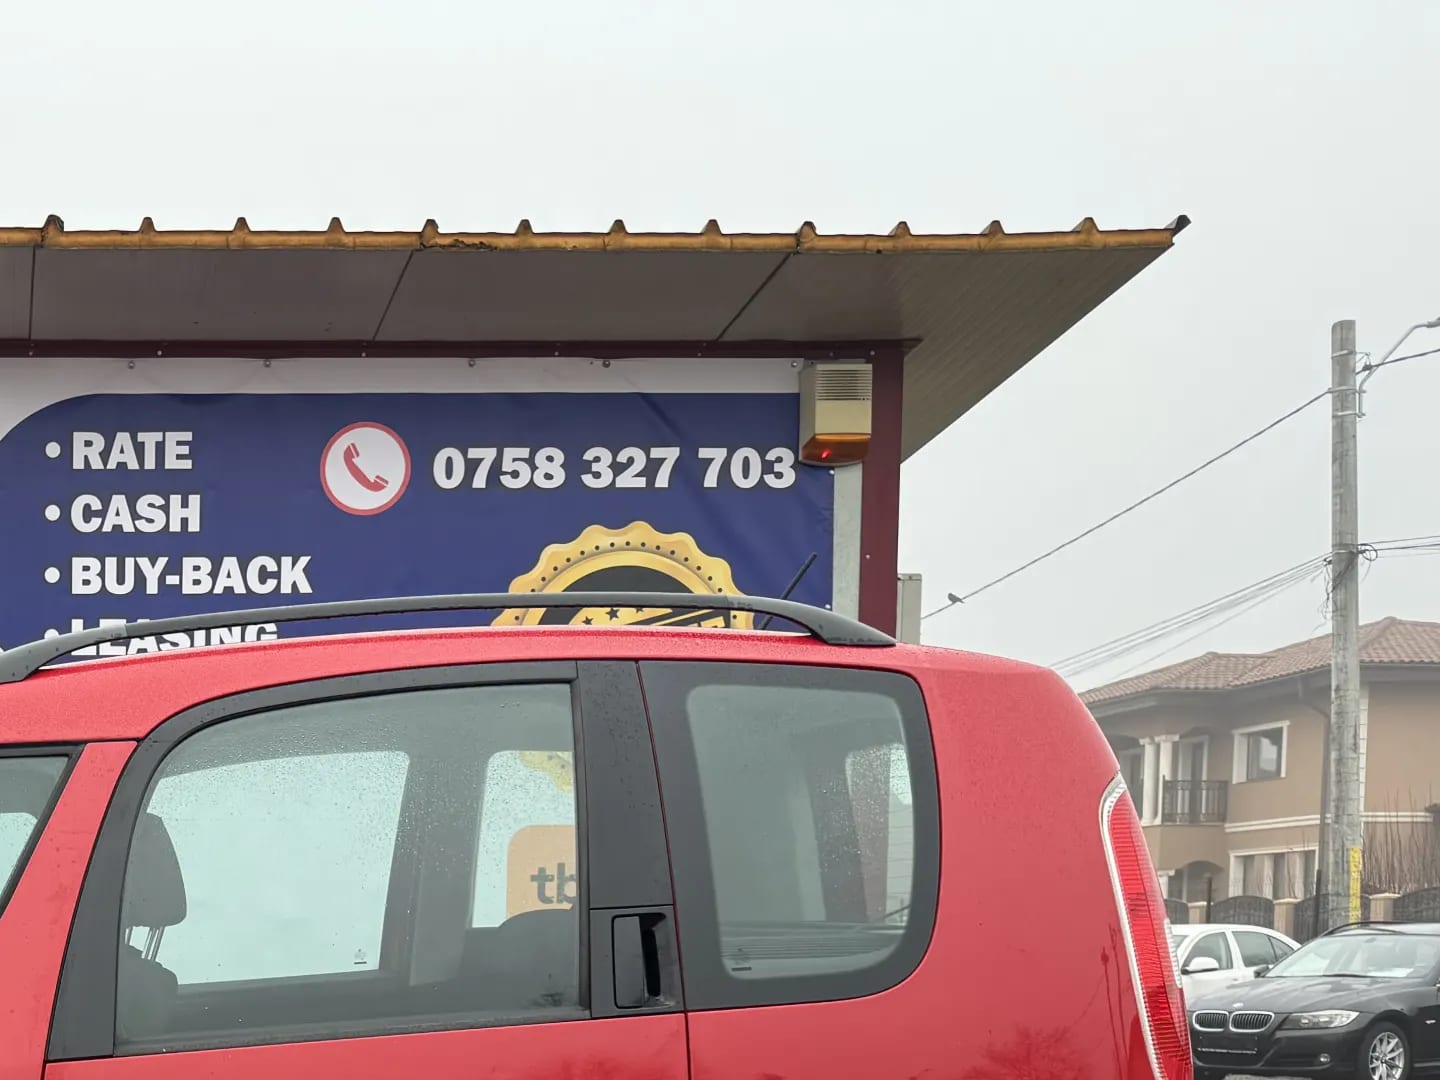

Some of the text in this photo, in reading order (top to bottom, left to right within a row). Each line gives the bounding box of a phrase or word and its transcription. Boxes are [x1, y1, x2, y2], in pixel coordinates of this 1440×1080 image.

[71, 431, 193, 470] RATE
[432, 446, 797, 489] 0758 327 703
[70, 494, 201, 533] CASH
[71, 555, 314, 595] BUY-BACK
